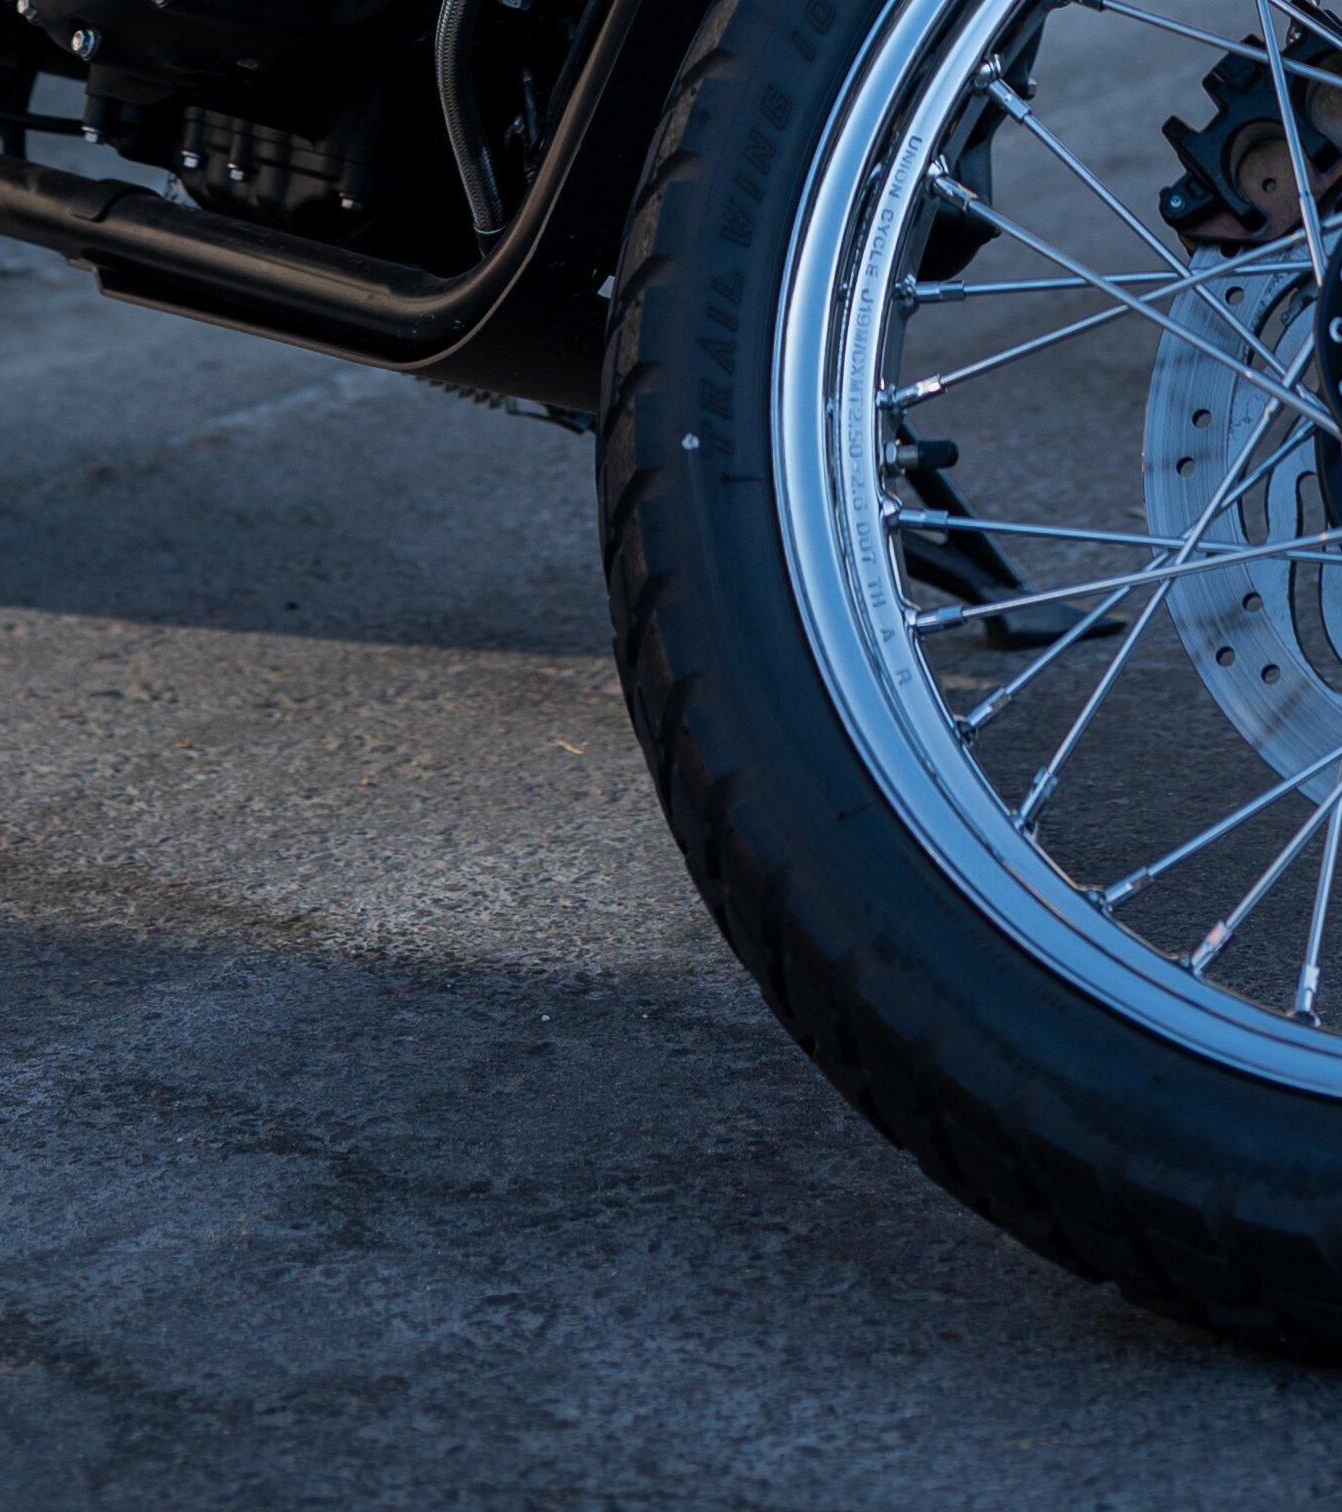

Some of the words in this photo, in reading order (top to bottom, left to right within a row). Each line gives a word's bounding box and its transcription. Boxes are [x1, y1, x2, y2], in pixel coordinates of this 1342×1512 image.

[720, 83, 794, 249] WING
[888, 135, 923, 199] UNION
[865, 208, 895, 278] CYCLE
[696, 267, 746, 460] TRAIL
[879, 627, 896, 644] A
[895, 668, 914, 686] R
